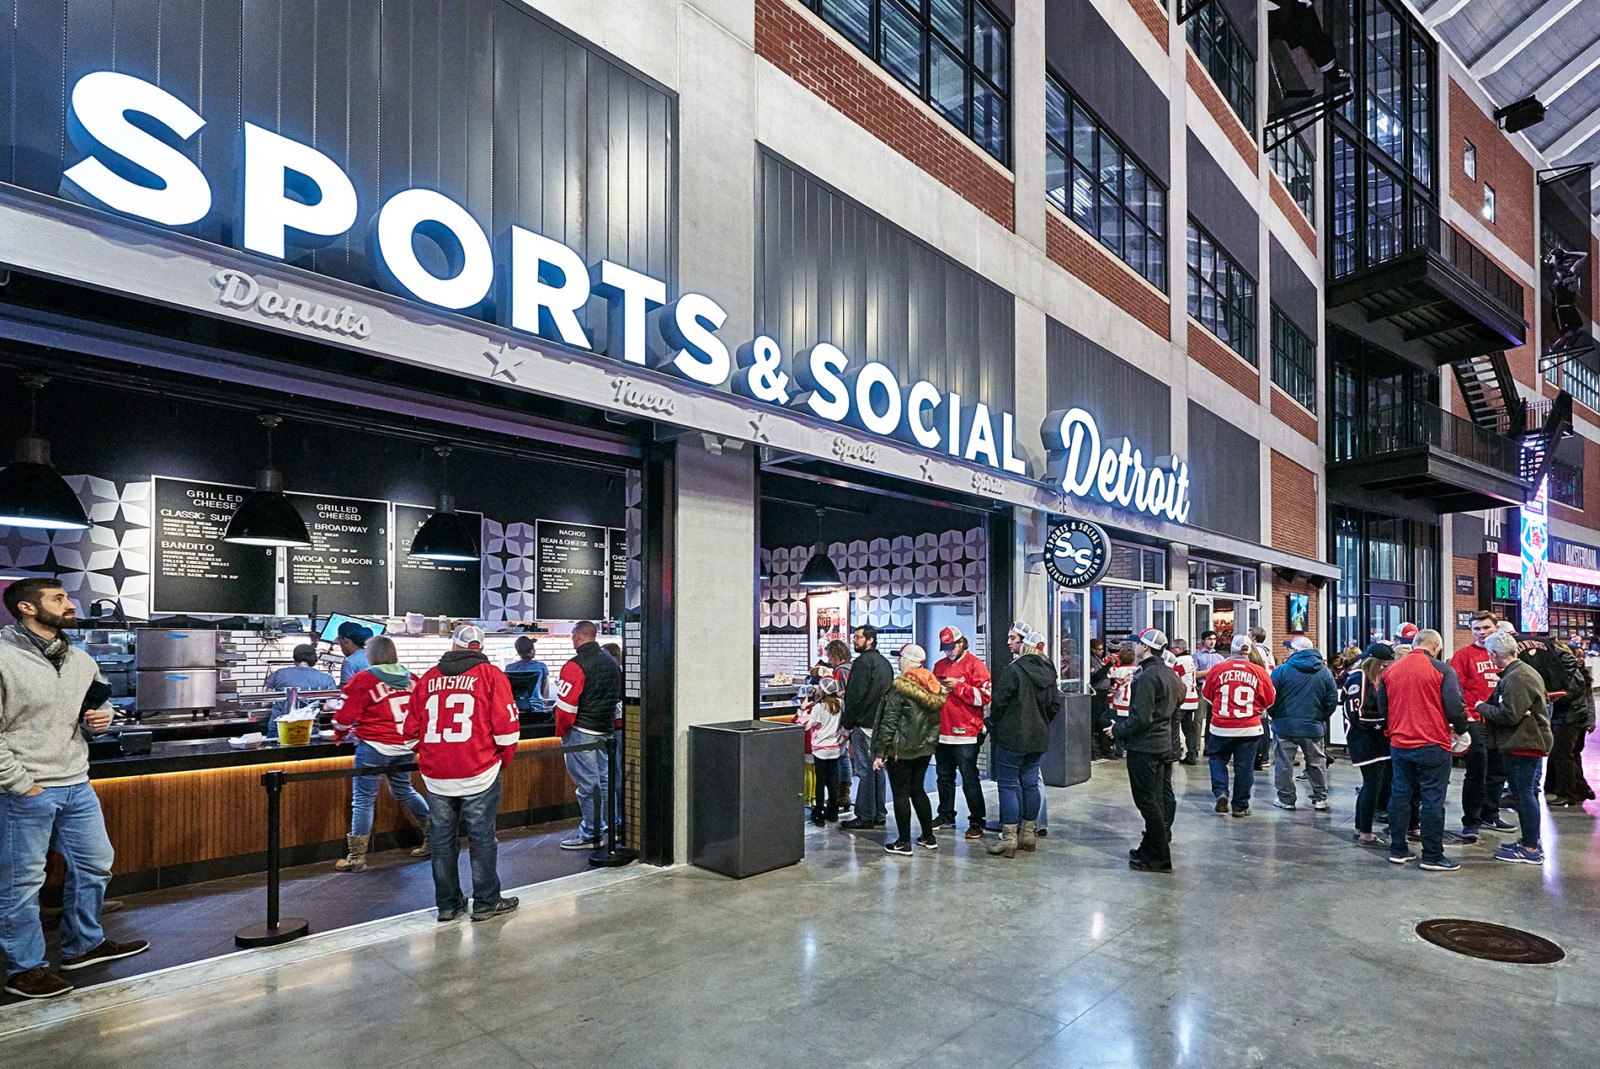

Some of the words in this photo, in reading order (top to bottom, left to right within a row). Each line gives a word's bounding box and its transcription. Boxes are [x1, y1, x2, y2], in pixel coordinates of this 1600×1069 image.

[62, 69, 731, 387] SPORTS
[747, 335, 790, 405] &
[806, 342, 1026, 476] SOCIAL
[1059, 407, 1191, 524] Detroit
[211, 268, 372, 339] Donuts
[611, 376, 677, 416] Tacos
[832, 435, 879, 464] Sports
[971, 471, 1007, 495] Spirits
[186, 489, 243, 503] GRILLED
[193, 498, 238, 510] CHEESE
[160, 508, 206, 520] CLASSIC
[316, 503, 358, 513] GRILLED
[318, 511, 362, 521] CHEESED
[314, 522, 368, 534] BROADWAY
[378, 527, 385, 535] 9
[558, 529, 586, 538] NACHOS
[1046, 523, 1069, 549] SPORTS
[1070, 521, 1076, 530] &
[1078, 522, 1101, 545] SOCIAL
[161, 540, 215, 552] BANDITO
[265, 548, 273, 556] 8
[540, 537, 558, 545] BEAN
[564, 539, 589, 547] CHEESE
[292, 555, 325, 563] AVOCA
[328, 556, 338, 564] O
[341, 556, 373, 566] BACON
[378, 558, 385, 566] 9
[540, 566, 567, 574] CHICKEN
[567, 568, 592, 576] GRANDE
[1072, 558, 1101, 585] MICHIGAN
[428, 675, 478, 693] DATSYUK
[1218, 669, 1259, 688] YZERMAN
[1219, 685, 1255, 719] 19
[1349, 698, 1360, 712] 13
[423, 693, 475, 744] 13
